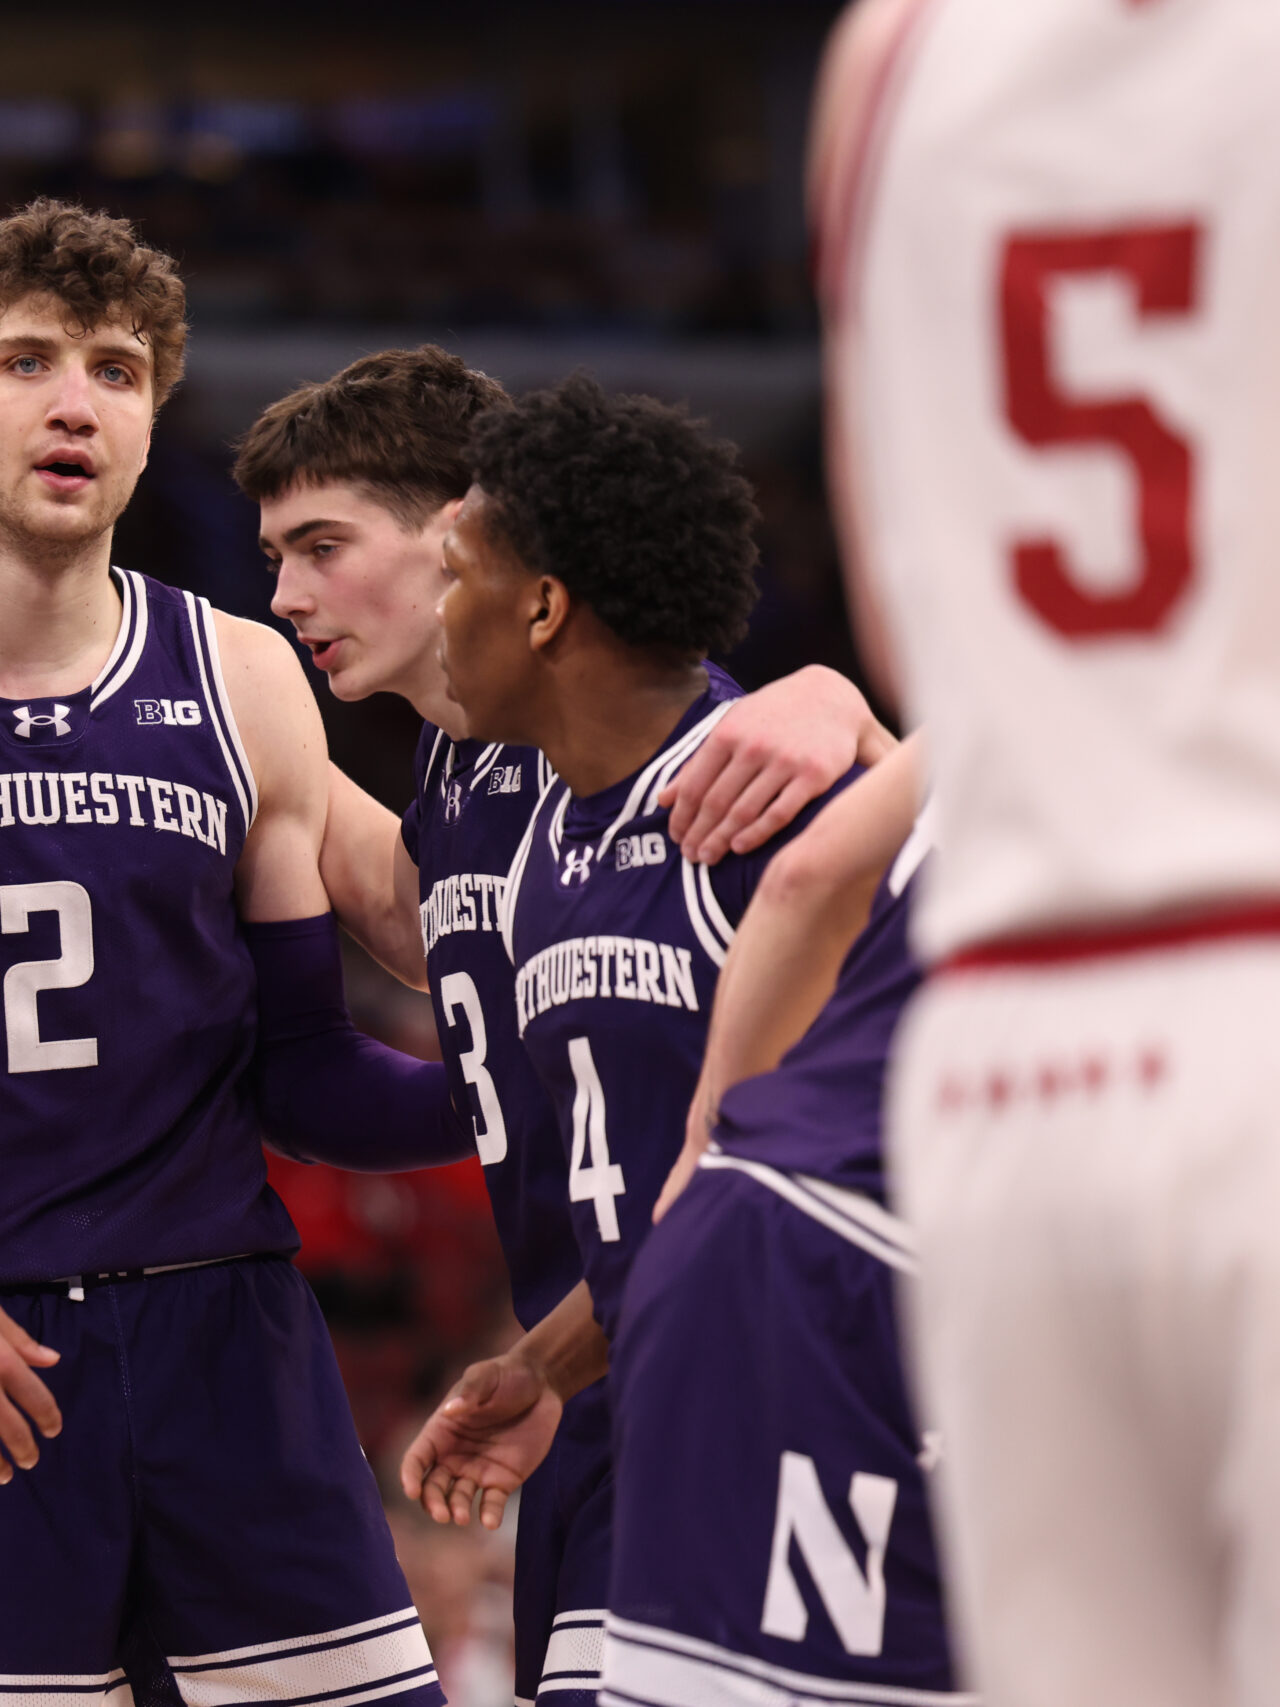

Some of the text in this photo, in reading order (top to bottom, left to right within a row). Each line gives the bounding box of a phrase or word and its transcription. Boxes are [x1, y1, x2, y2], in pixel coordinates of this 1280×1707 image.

[997, 220, 1202, 642] 5
[440, 971, 508, 1166] 3
[568, 1036, 626, 1242] 4
[760, 1449, 898, 1658] N
